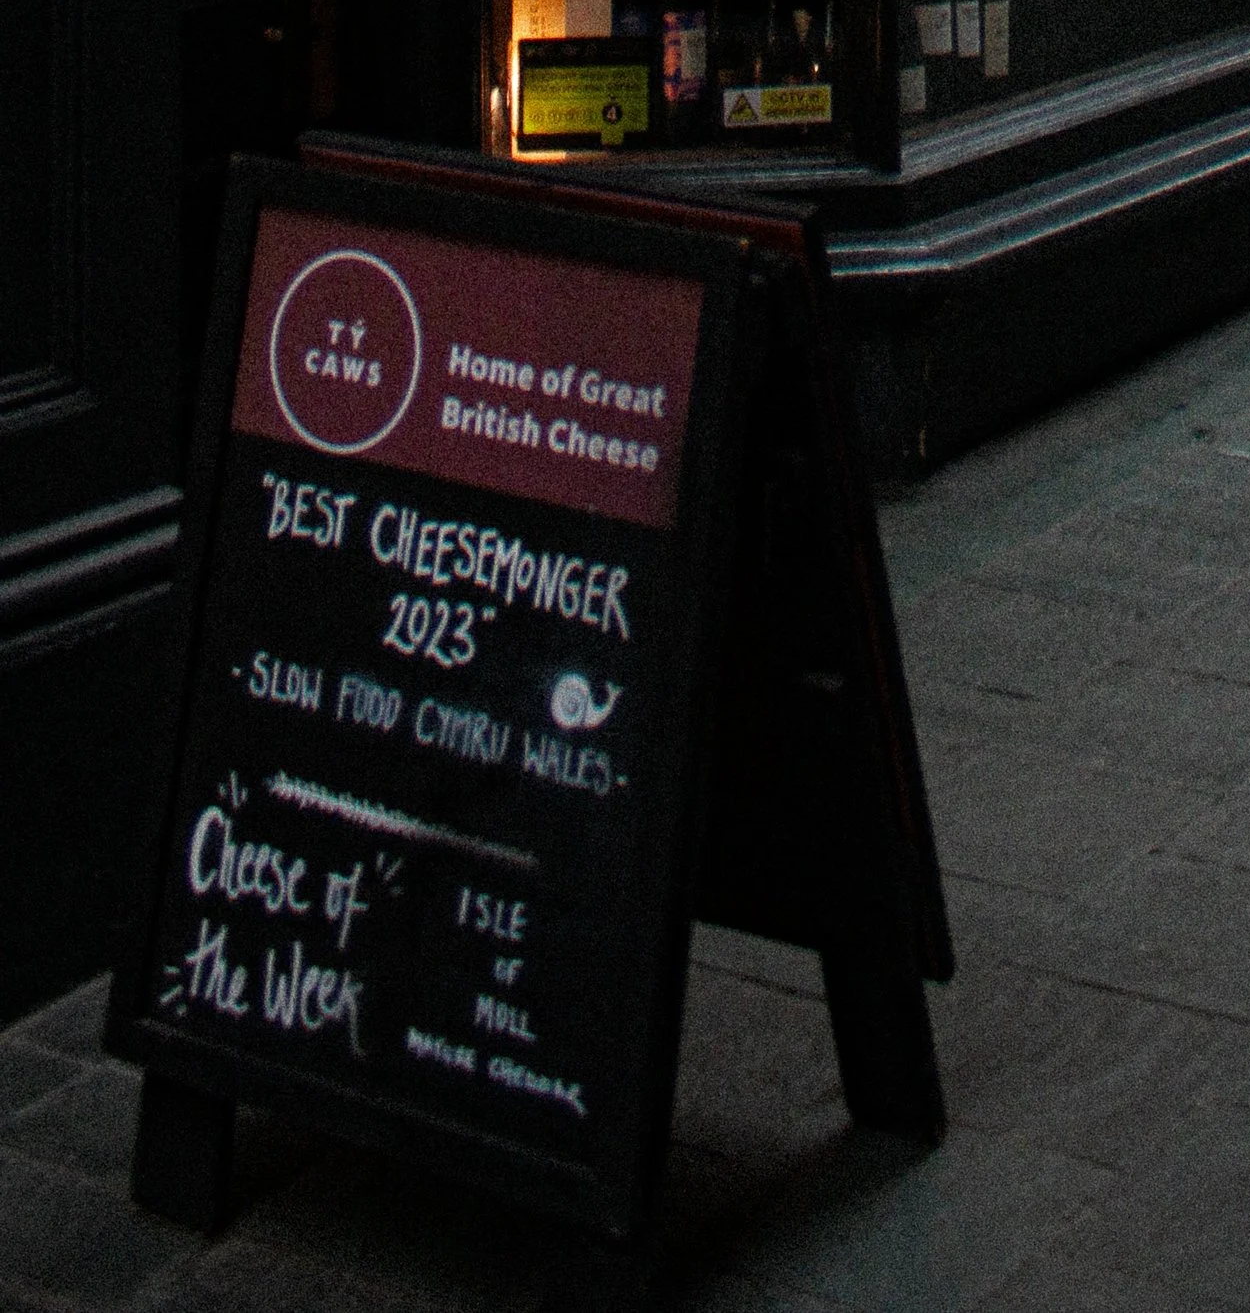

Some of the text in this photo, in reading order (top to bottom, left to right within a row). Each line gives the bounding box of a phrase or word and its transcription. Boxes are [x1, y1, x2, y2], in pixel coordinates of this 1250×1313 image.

[303, 349, 384, 389] CAWS
[447, 342, 667, 419] Home of Great
[440, 395, 661, 473] British Cheese
[370, 500, 632, 643] CHEESEMONGER
[246, 646, 324, 713] SLOW
[334, 670, 401, 735] FOOD
[413, 694, 512, 766] CYMRU
[189, 803, 370, 951] Cheese of
[457, 884, 528, 945] ISLE
[262, 938, 369, 1061] Week
[472, 991, 539, 1044] MULL
